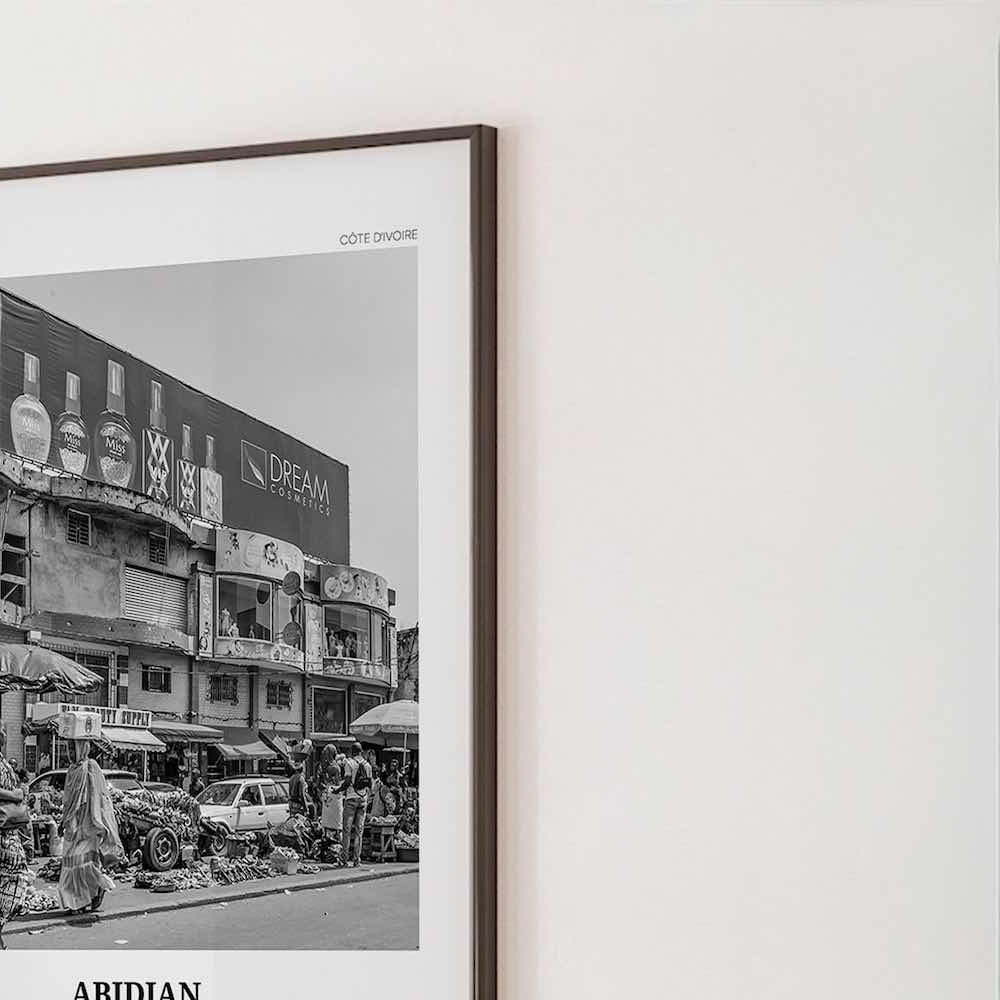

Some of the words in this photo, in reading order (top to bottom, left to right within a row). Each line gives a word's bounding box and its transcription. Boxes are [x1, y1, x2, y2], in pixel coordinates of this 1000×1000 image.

[339, 231, 370, 246] CÔTE
[374, 228, 418, 243] D'IVOIRE
[64, 432, 81, 447] Miss
[105, 437, 126, 454] Miss
[270, 453, 330, 505] DREAM
[270, 483, 331, 516] COSMETICS
[122, 710, 150, 727] SUPPLY
